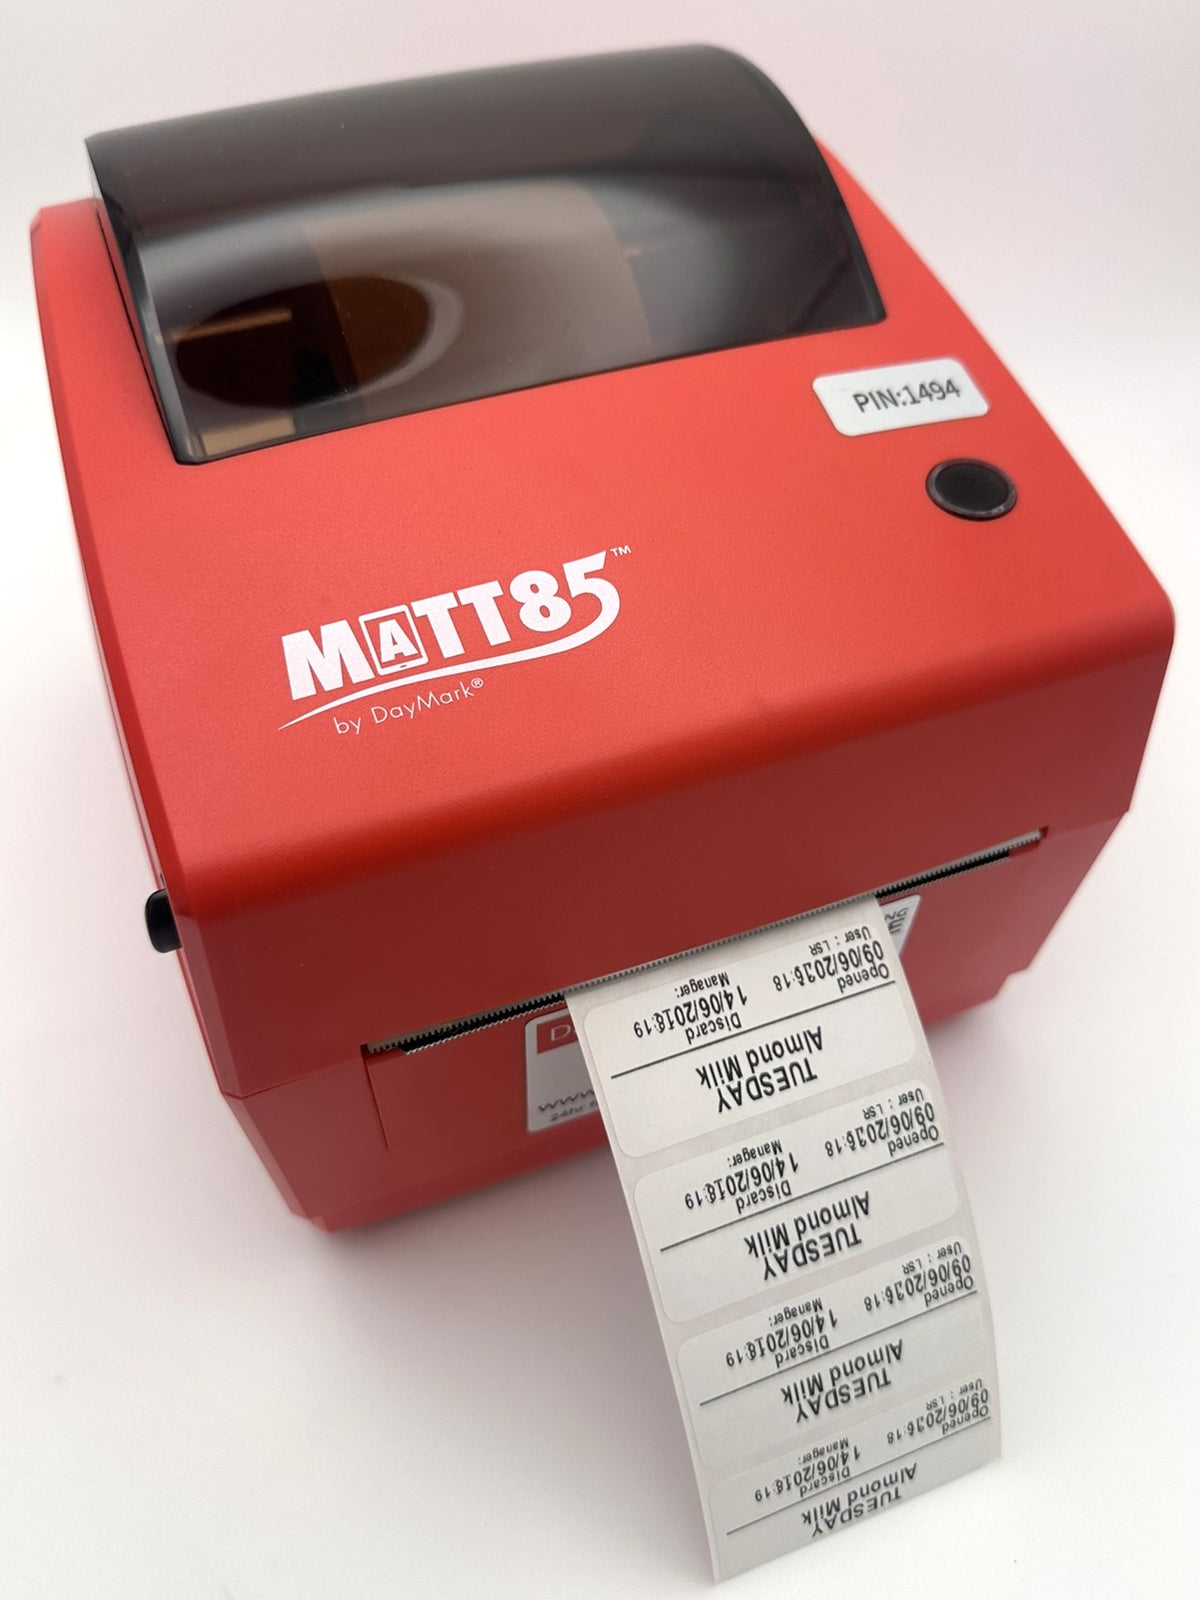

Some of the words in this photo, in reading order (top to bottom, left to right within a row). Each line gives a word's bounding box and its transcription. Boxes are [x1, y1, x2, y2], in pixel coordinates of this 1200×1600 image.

[852, 378, 961, 414] PIN:1494
[333, 716, 362, 736] by
[810, 941, 831, 956] LSR
[845, 926, 872, 943] User
[674, 972, 730, 999] Manager:
[837, 962, 890, 993] Opened
[685, 1012, 742, 1044] Discard
[748, 1026, 824, 1063] Almond
[696, 1054, 741, 1090] Milk
[717, 1057, 818, 1114] TUESDAY
[862, 1103, 884, 1120] LSR
[897, 1088, 924, 1104] User
[726, 1138, 783, 1168] Manager:
[887, 1124, 940, 1156] Opened
[735, 1179, 792, 1214] Discard
[793, 1190, 871, 1240] Almond
[743, 1222, 790, 1258] Milk
[763, 1222, 862, 1281] TUESDAY
[936, 1241, 962, 1260] User
[902, 1257, 923, 1275] LSR
[923, 1274, 974, 1307] Opened
[768, 1296, 824, 1328] Manager:
[774, 1333, 830, 1368] Discard
[829, 1338, 904, 1387] Almond
[780, 1371, 824, 1406] Milk
[795, 1367, 892, 1423] TUESDAY
[959, 1378, 983, 1395] User
[940, 1404, 989, 1436] Opened
[798, 1436, 850, 1466] Manager:
[799, 1465, 851, 1498] Discard
[846, 1462, 918, 1503] Almond
[800, 1497, 841, 1526] Milk
[811, 1485, 903, 1538] TUESDAY
